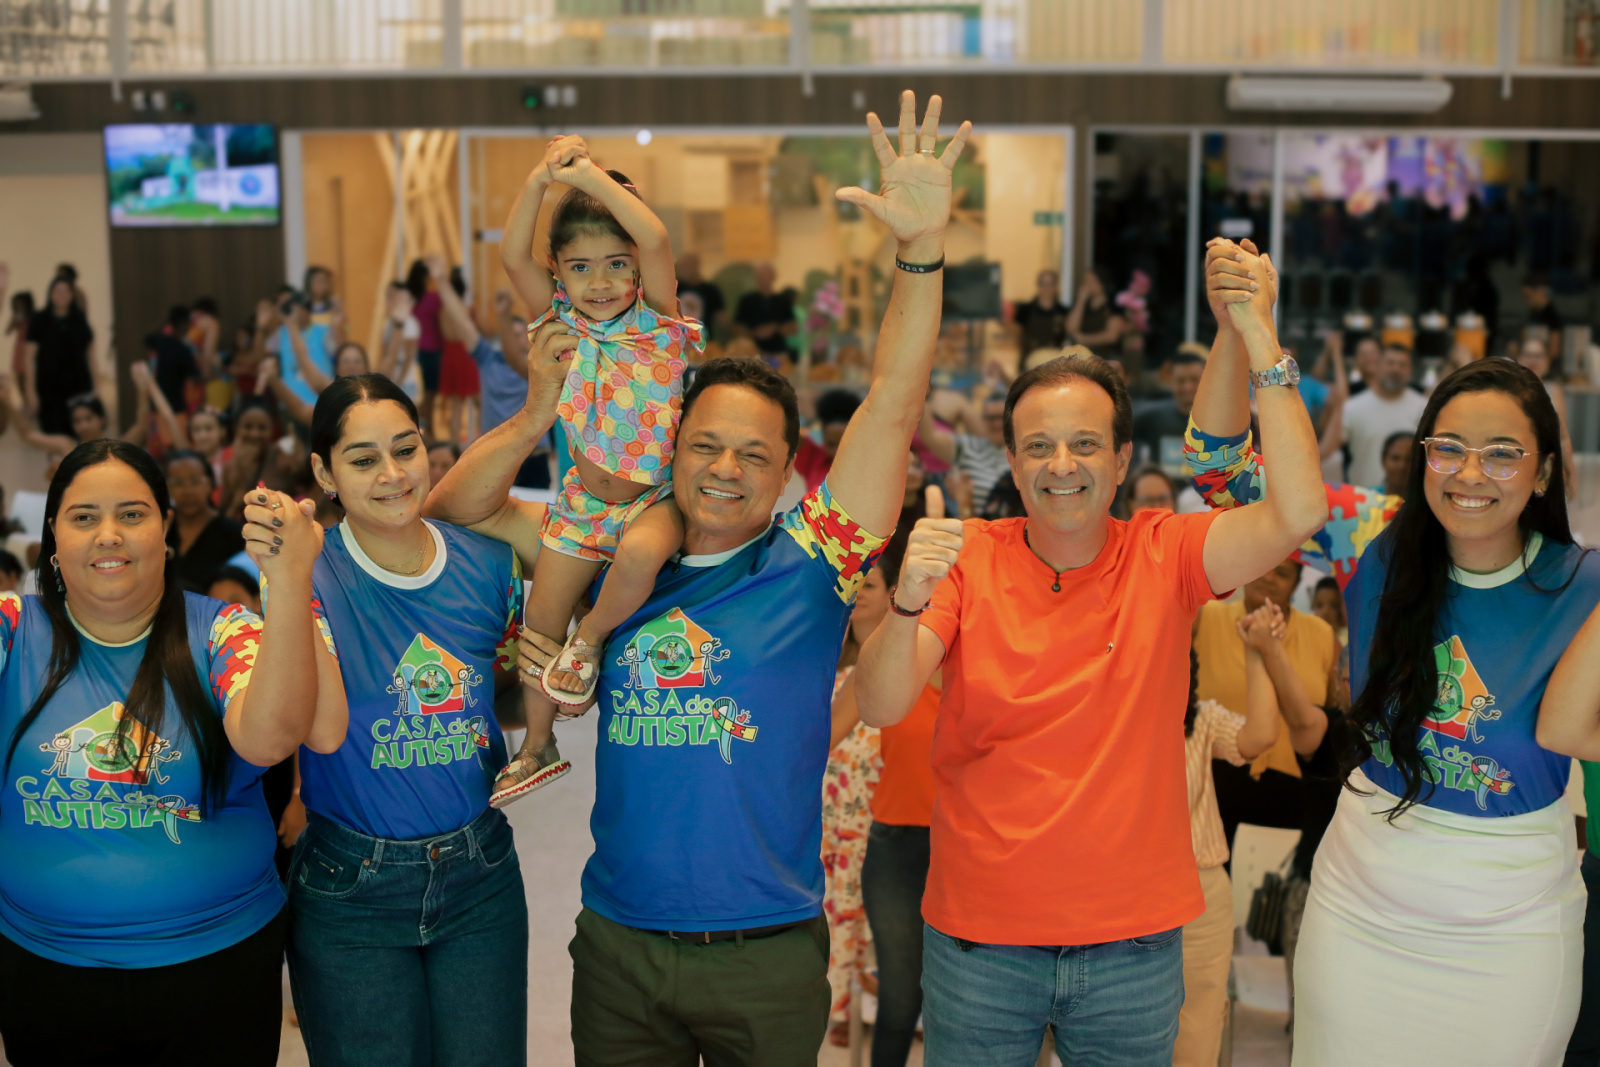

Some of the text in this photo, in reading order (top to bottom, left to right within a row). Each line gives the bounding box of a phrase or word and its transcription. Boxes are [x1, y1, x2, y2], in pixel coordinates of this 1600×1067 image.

[611, 689, 714, 715] CASA do
[371, 714, 470, 742] CASA do
[609, 715, 723, 746] AUTISTA
[371, 735, 477, 769] AUTISTA
[1443, 745, 1475, 767] do
[16, 776, 159, 805] CASA do
[24, 800, 166, 829] AUTISTA
